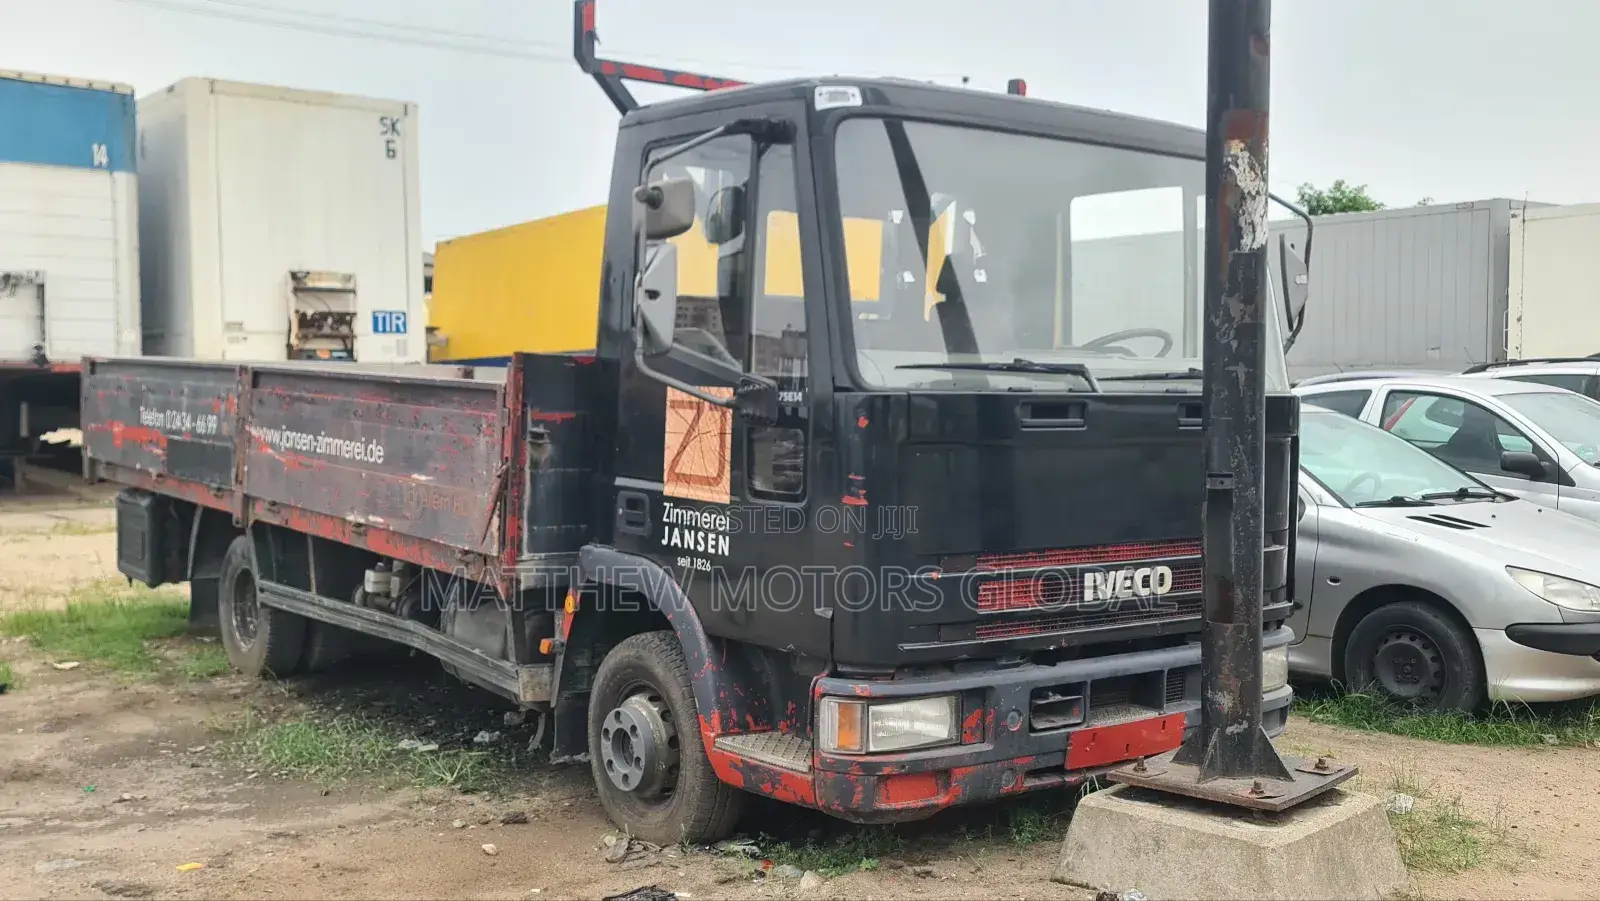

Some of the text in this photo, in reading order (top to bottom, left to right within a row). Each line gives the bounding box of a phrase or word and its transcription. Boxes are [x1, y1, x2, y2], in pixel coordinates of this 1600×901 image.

[380, 116, 400, 137] SK
[92, 143, 109, 168] 14
[386, 140, 396, 159] 6
[375, 311, 405, 333] TIR
[662, 502, 730, 532] Zimmerei
[661, 525, 730, 556] JANSEN
[677, 556, 711, 571] seit 1826
[1084, 565, 1173, 601] IVECO
